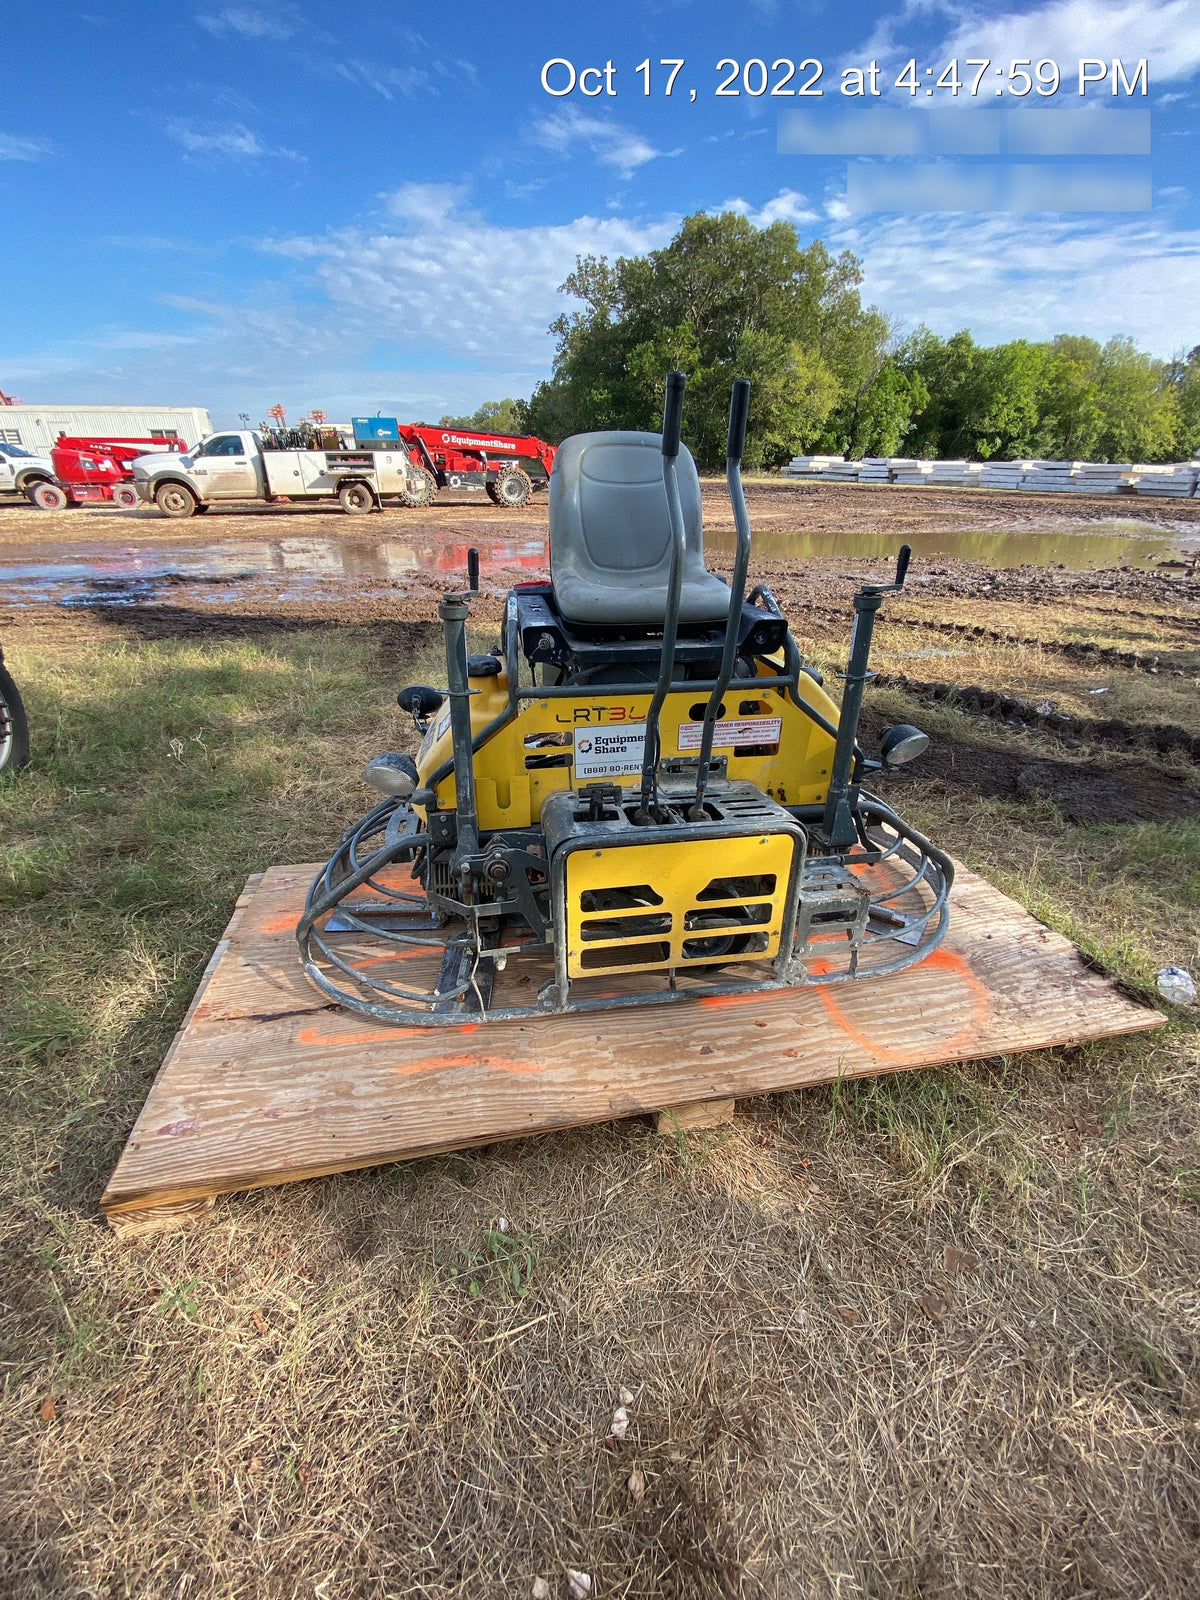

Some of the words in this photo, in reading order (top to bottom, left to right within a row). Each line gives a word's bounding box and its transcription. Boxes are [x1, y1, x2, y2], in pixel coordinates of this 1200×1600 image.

[451, 435, 516, 449] EquipmentShare
[734, 719, 781, 728] RESPONSIBILITY
[594, 735, 646, 749] Equipme
[594, 745, 628, 755] Share
[583, 766, 607, 775] (888)
